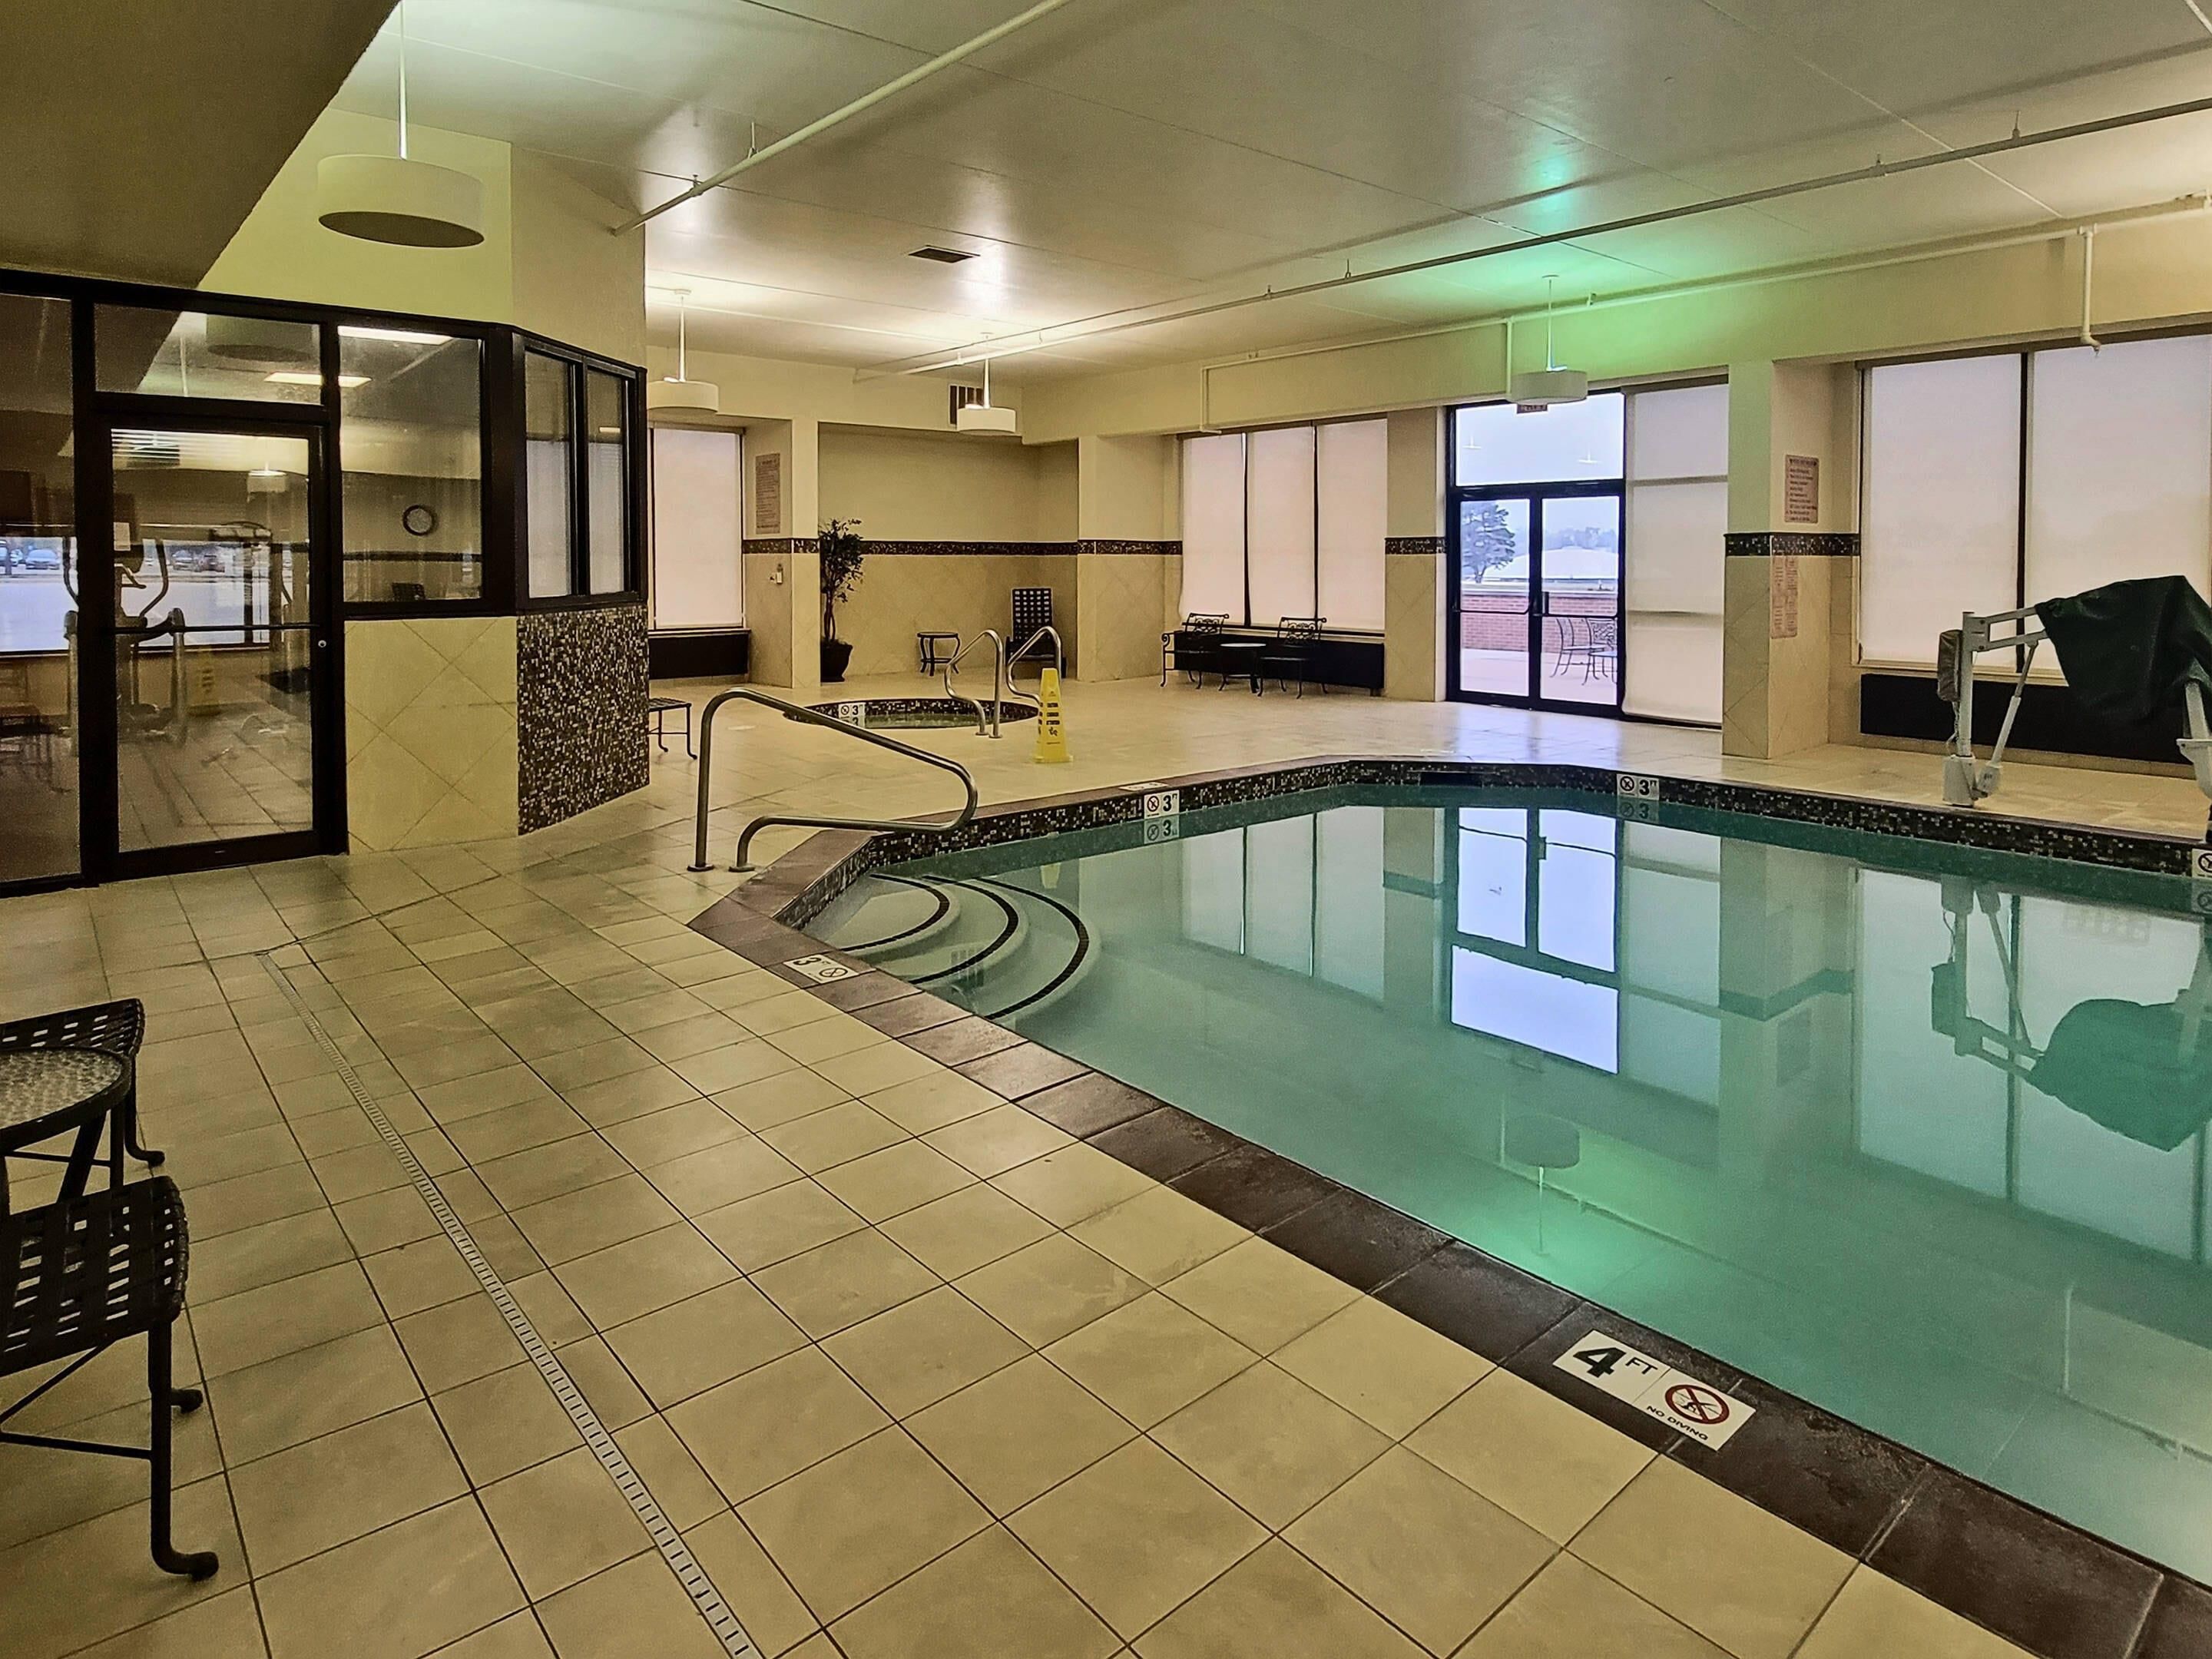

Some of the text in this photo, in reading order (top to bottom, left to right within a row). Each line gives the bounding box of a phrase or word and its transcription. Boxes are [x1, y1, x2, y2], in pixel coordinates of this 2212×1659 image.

[853, 705, 859, 715] 3
[1639, 779, 1650, 795] 3
[1163, 794, 1172, 812] 3
[793, 957, 822, 965] 3
[1573, 1347, 1658, 1378] 4 FT
[1646, 1405, 1709, 1441] NO DIVING
